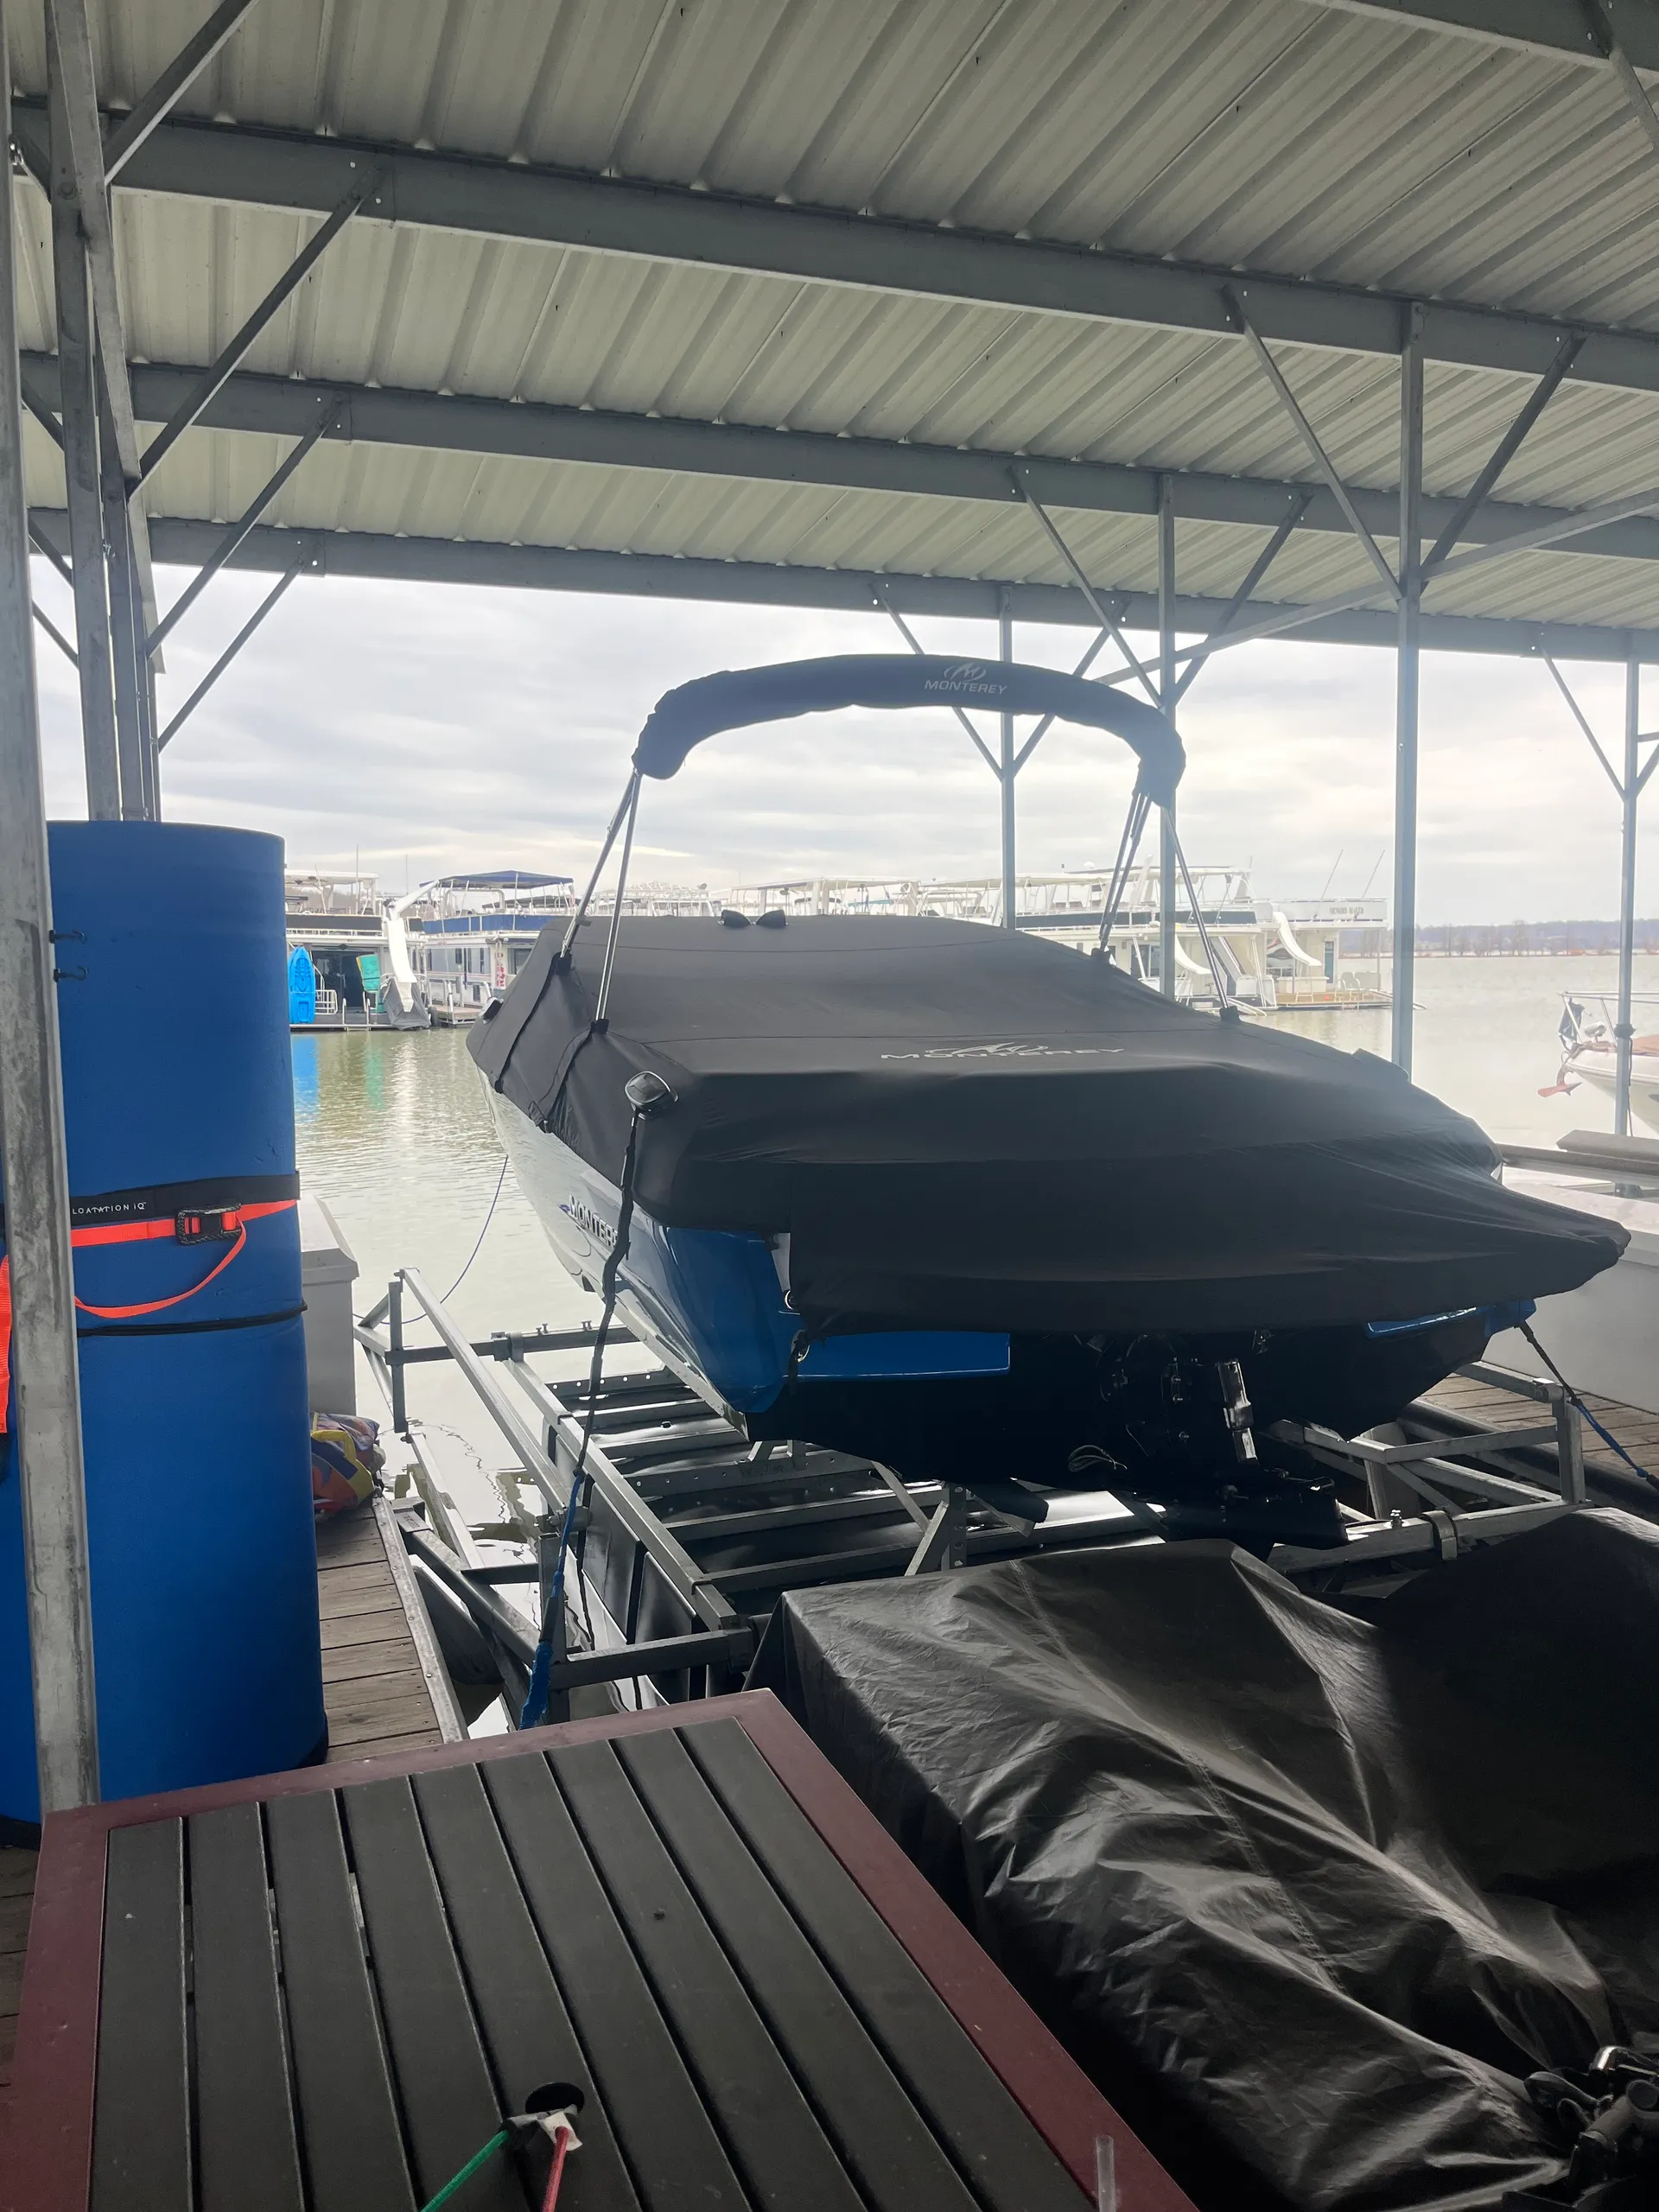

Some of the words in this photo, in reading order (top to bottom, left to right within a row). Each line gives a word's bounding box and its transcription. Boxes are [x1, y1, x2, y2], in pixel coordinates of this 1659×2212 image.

[924, 680, 1008, 695] MONTEREY
[880, 1048, 1125, 1059] MONTEREY
[72, 1204, 130, 1215] LOATATION
